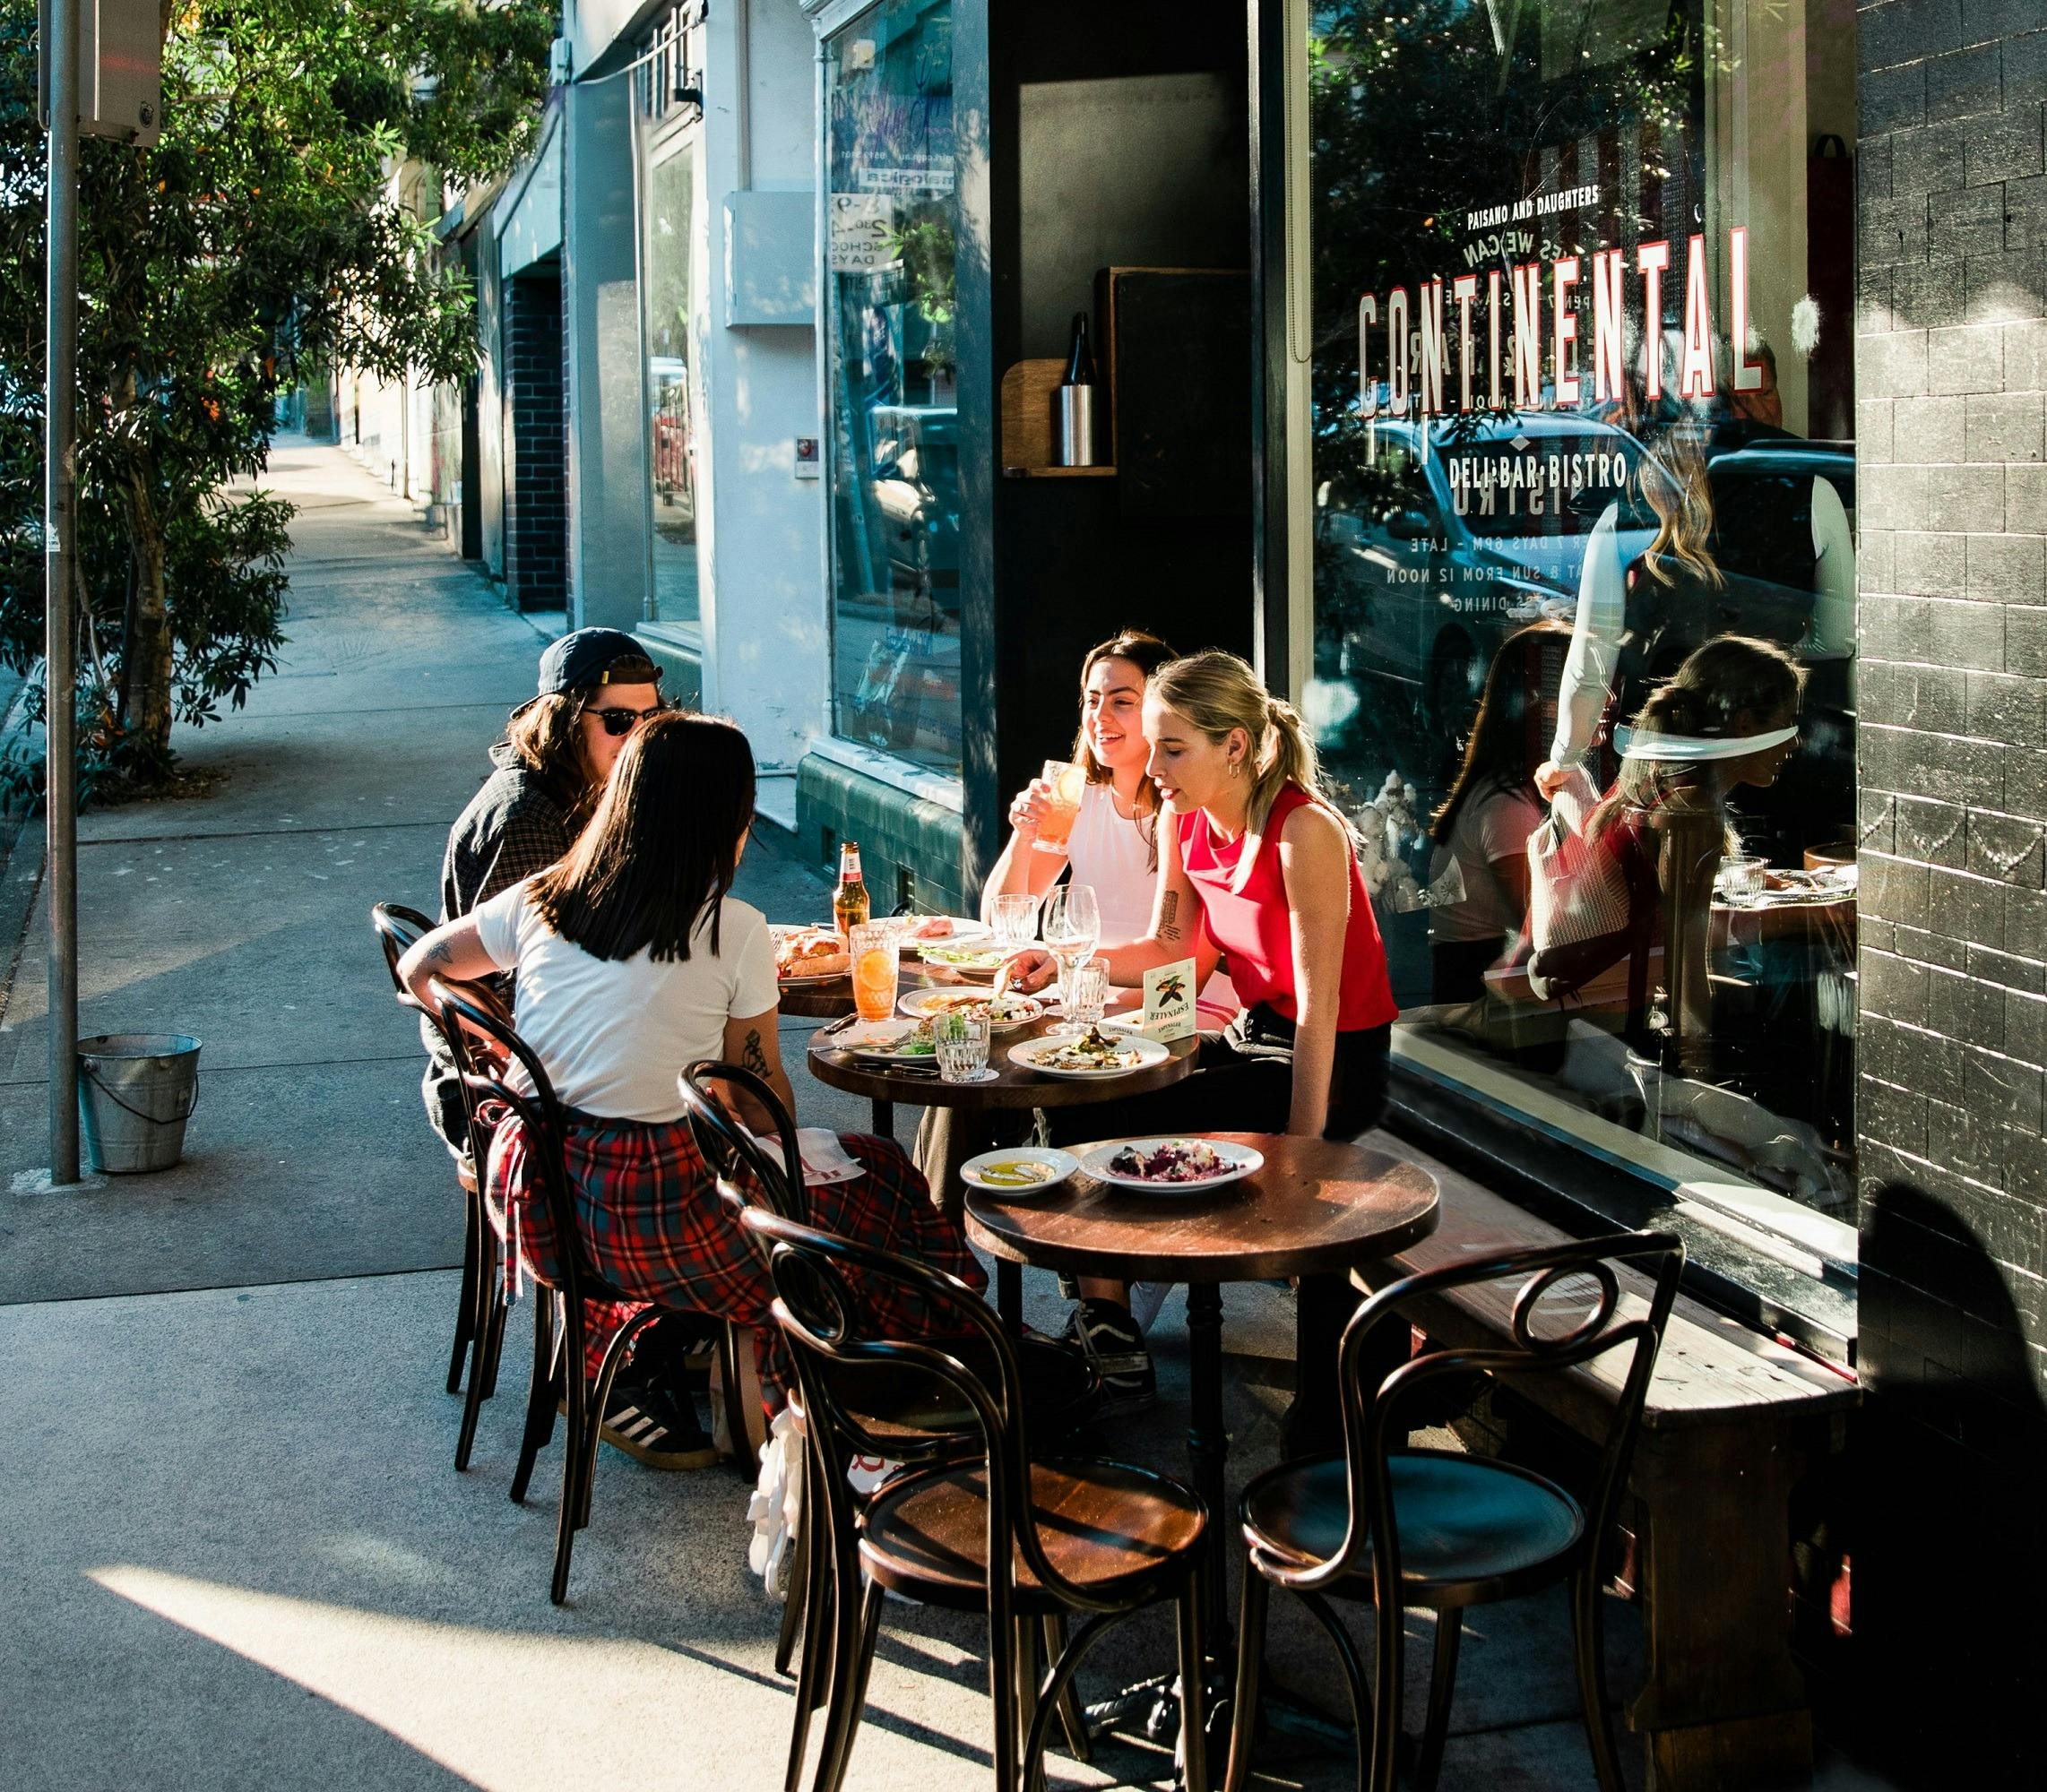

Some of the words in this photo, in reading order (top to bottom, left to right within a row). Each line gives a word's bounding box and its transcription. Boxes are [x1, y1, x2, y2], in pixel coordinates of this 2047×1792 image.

[1467, 203, 1508, 230] PAISANO
[1512, 198, 1533, 222] AND
[1537, 184, 1600, 215] DAUGHTERS
[1359, 225, 1764, 420] CONTINENTAL
[1449, 457, 1490, 490] DELI
[1502, 455, 1539, 489] BAR
[1549, 452, 1628, 488] BISTRO
[1149, 1002, 1189, 1021] ESPINALER
